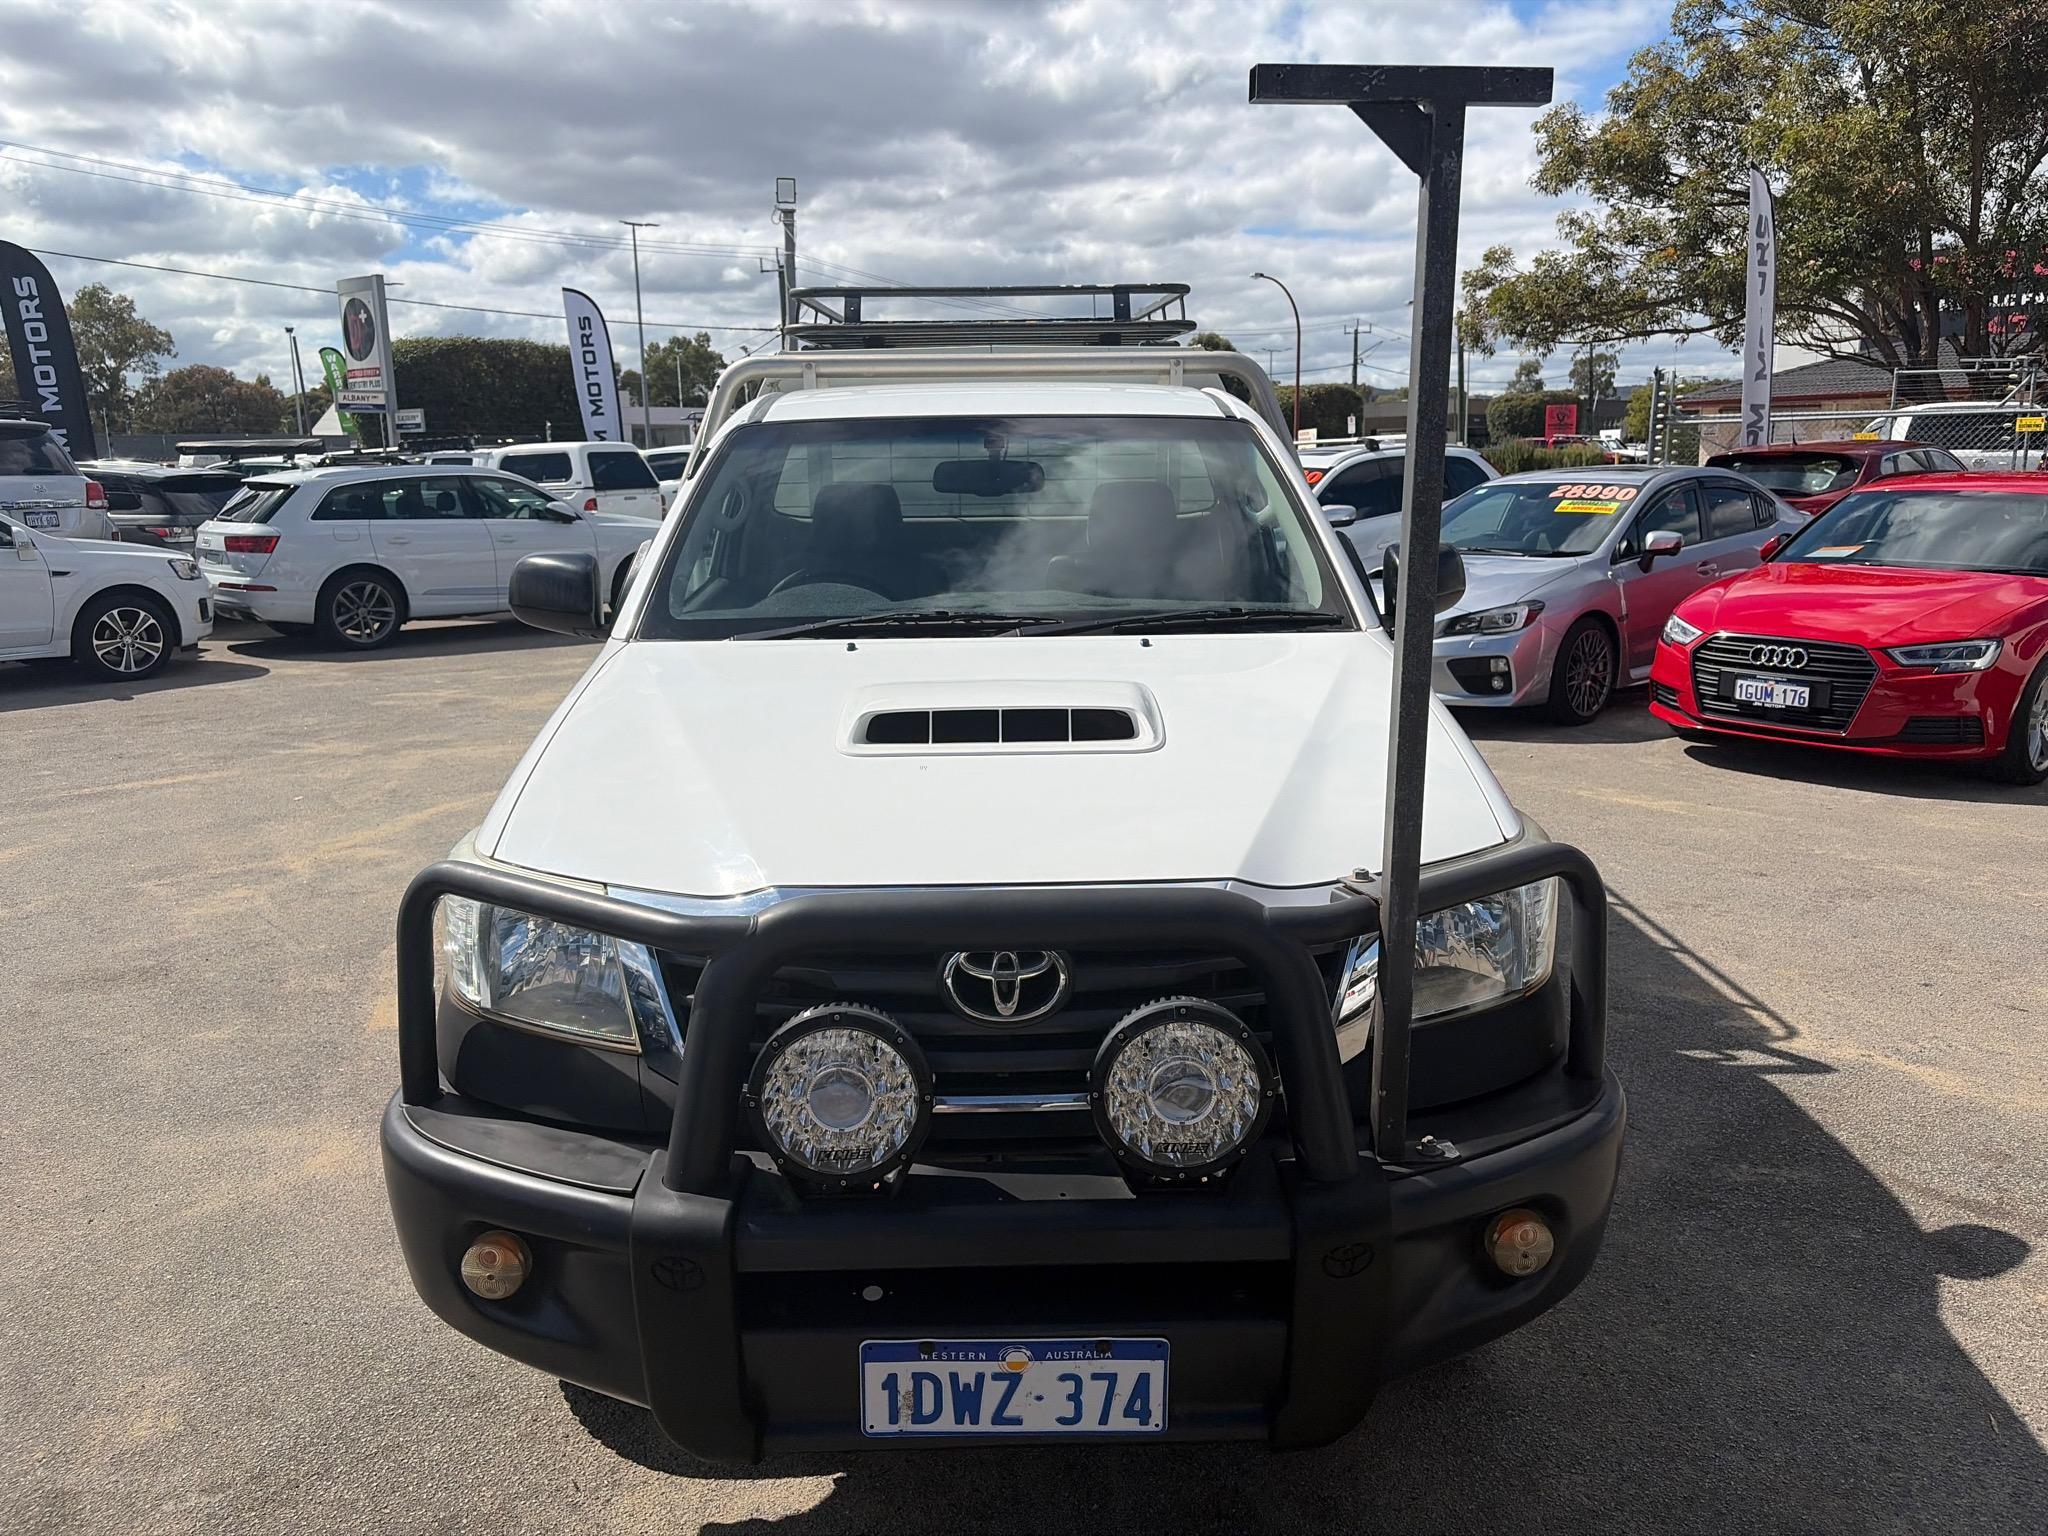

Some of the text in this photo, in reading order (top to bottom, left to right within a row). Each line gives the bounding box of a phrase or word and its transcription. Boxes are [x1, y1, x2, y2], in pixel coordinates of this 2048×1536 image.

[13, 276, 62, 413] MOTORS
[578, 315, 605, 417] MOTORS
[342, 394, 371, 402] ALBANY
[1549, 484, 1637, 501] 28990
[920, 1350, 1113, 1361] WESTERN AUSTRALIA
